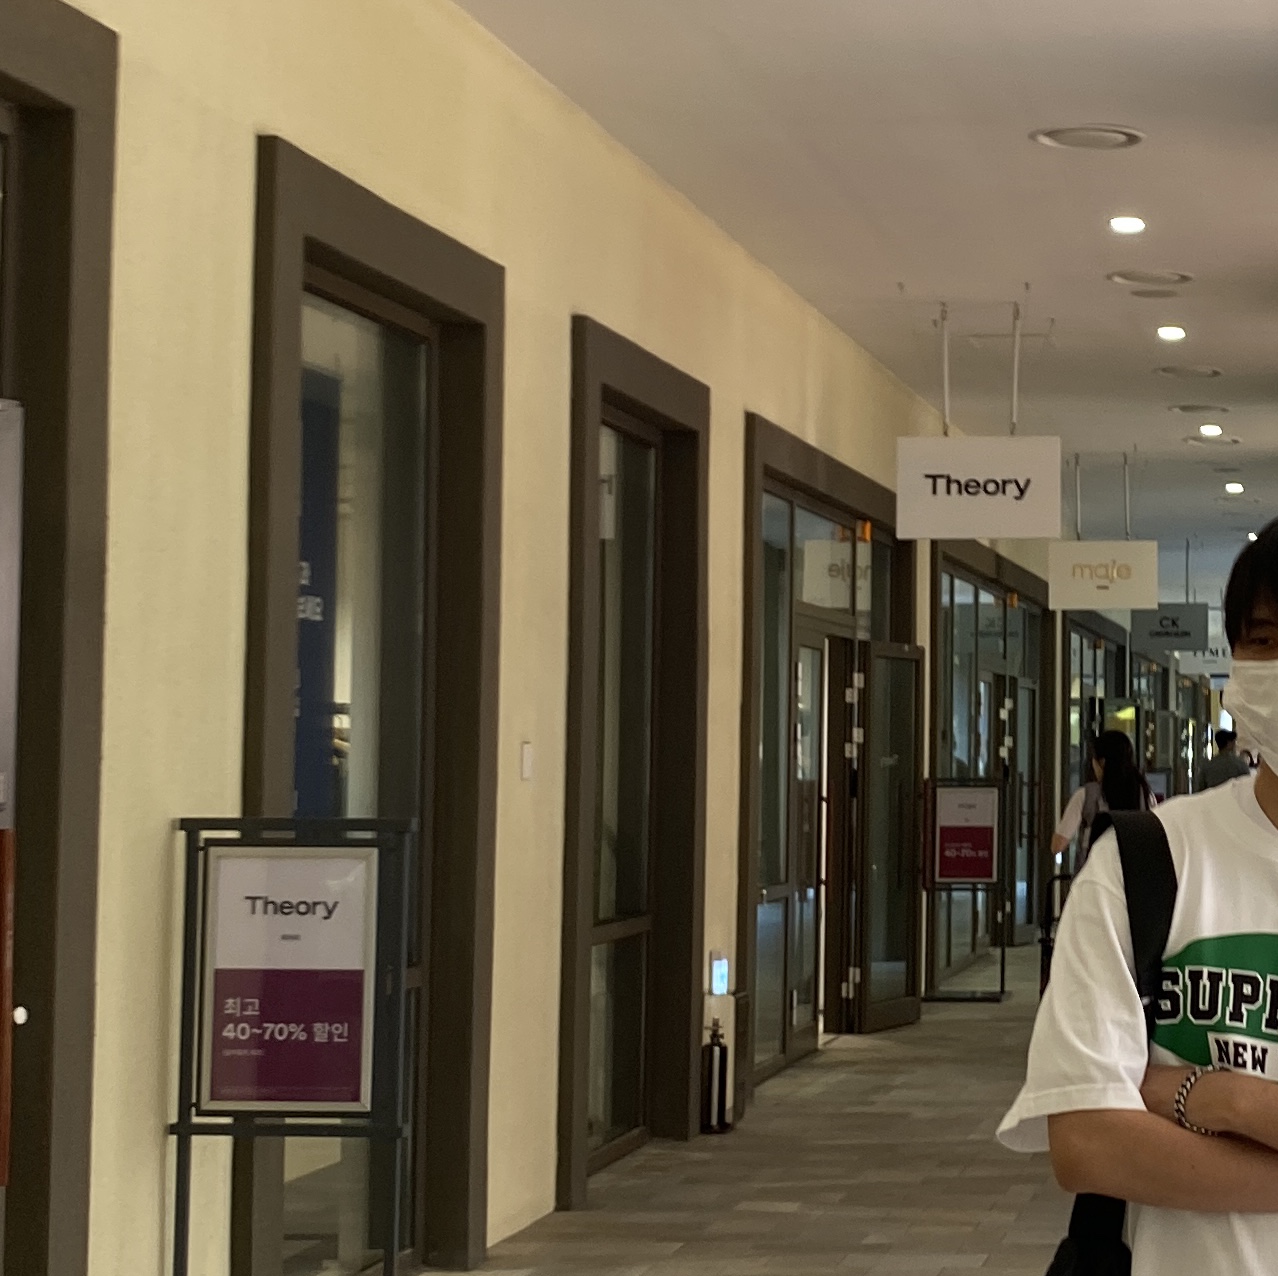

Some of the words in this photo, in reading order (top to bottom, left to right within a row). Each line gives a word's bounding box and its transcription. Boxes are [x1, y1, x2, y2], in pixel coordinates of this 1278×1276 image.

[925, 473, 1031, 501] Theory
[1072, 559, 1131, 583] maje
[1159, 616, 1180, 629] CK
[245, 896, 340, 920] Theory
[224, 997, 260, 1017] 최고
[222, 1022, 308, 1041] 40~70%
[313, 1021, 349, 1042] 할인
[1214, 1038, 1269, 1075] NEW
